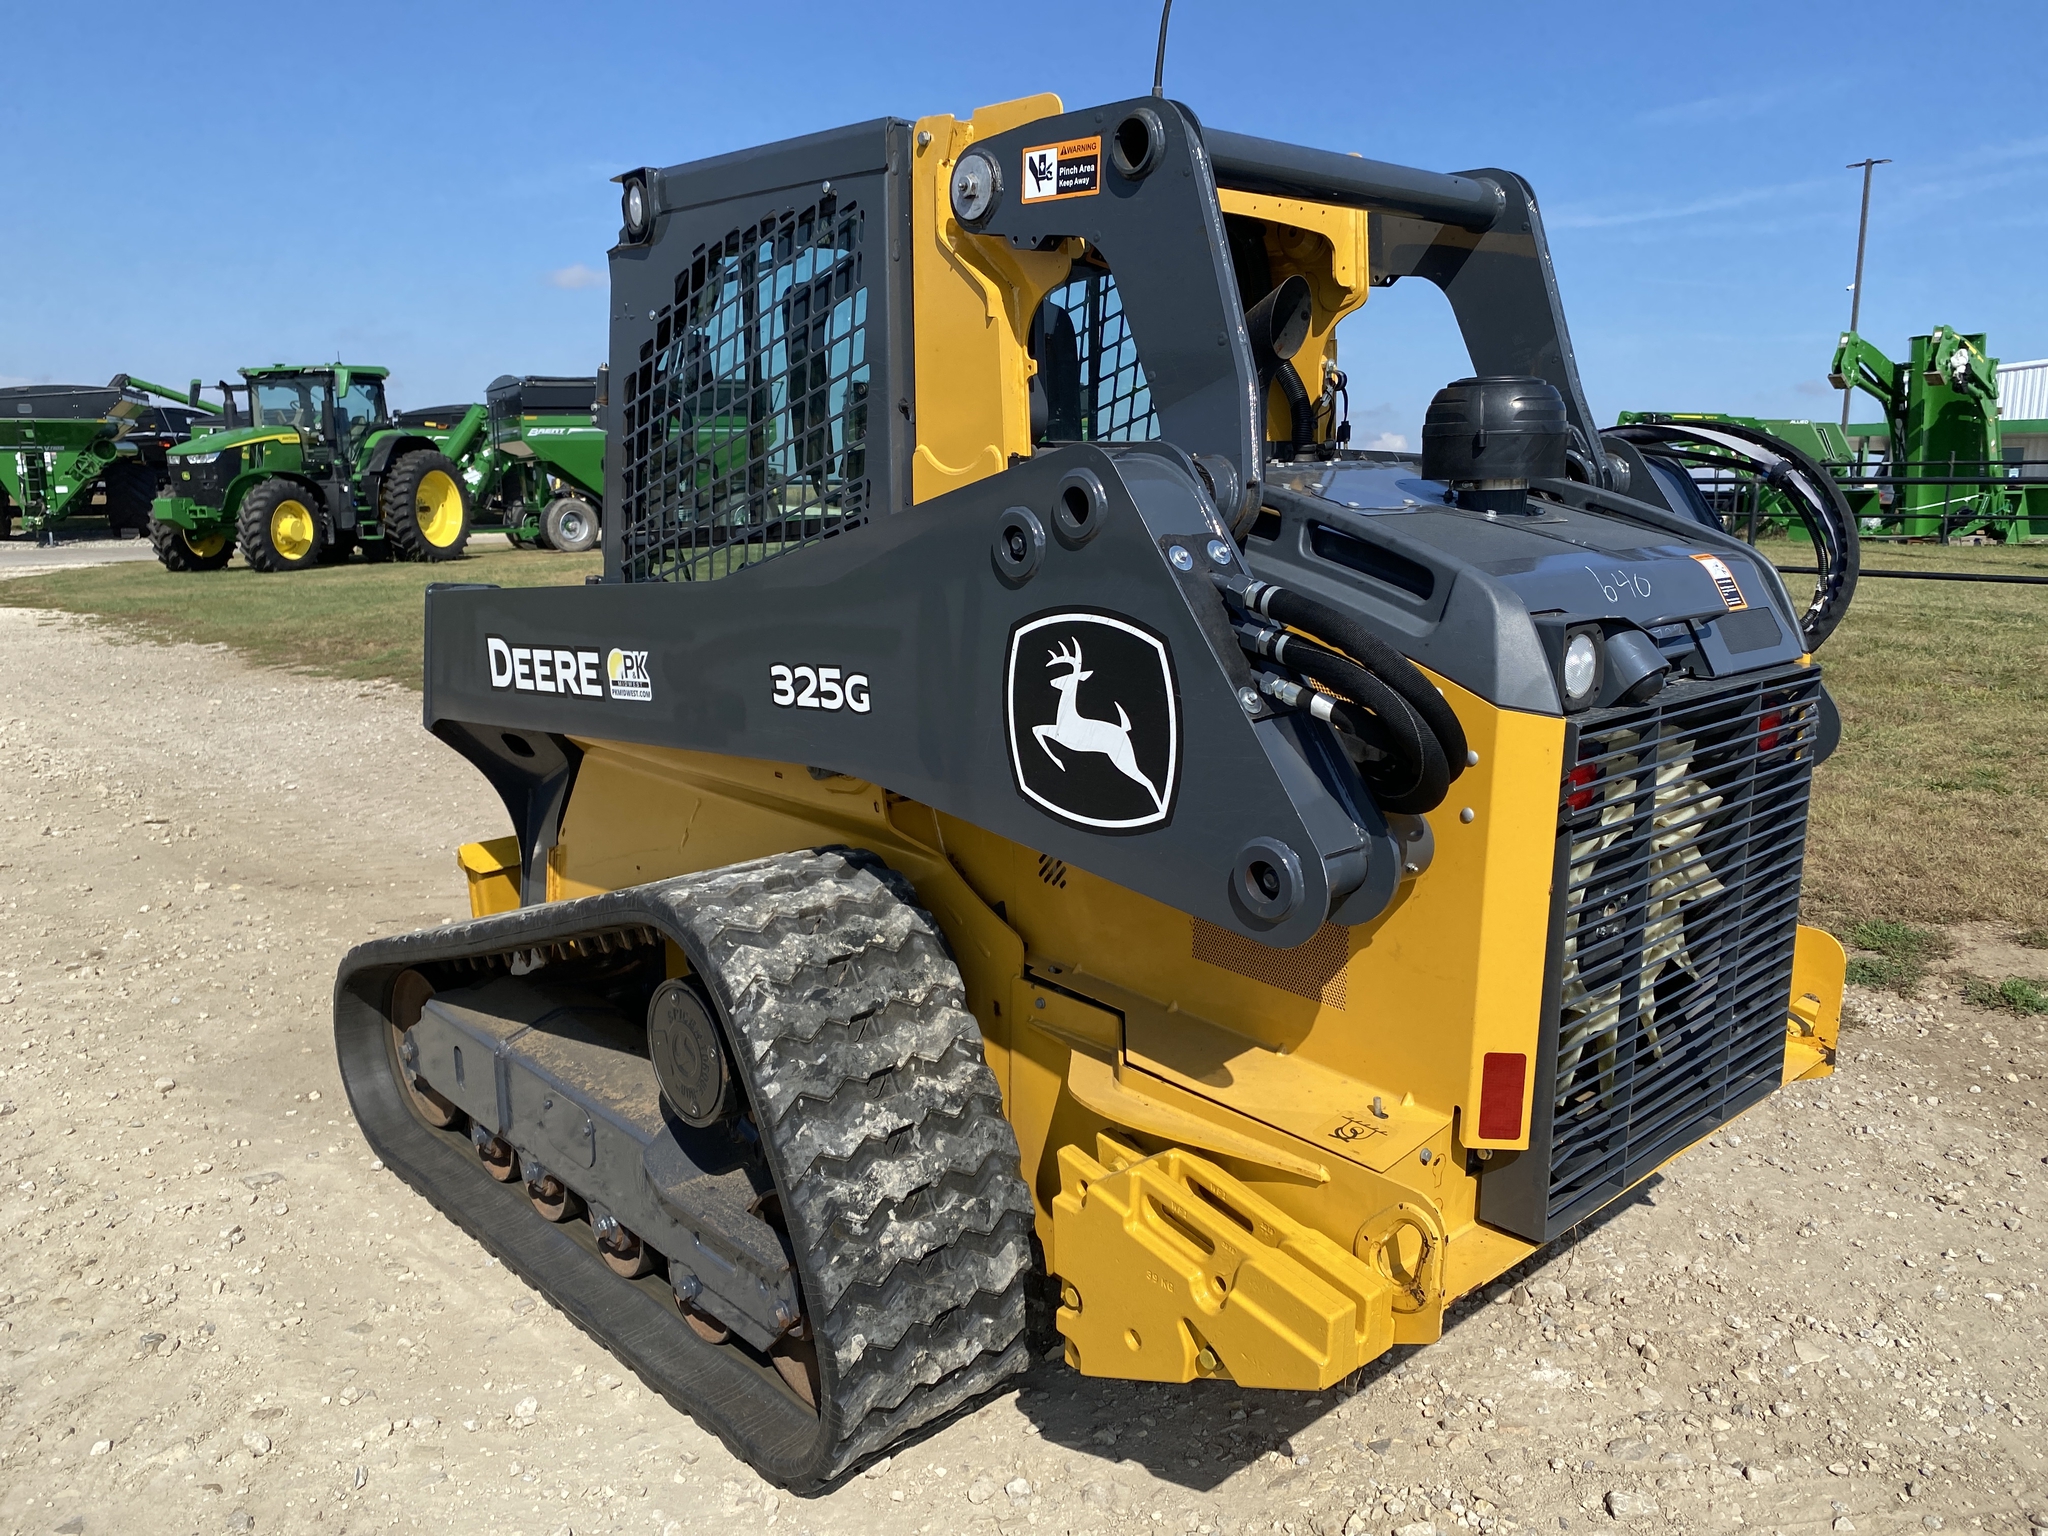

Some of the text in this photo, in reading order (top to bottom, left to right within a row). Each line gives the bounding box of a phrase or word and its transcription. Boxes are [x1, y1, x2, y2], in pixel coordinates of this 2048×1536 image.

[1066, 142, 1097, 154] WARNING
[1059, 164, 1095, 176] Pinch Area
[1059, 177, 1090, 188] Keep Away
[527, 428, 565, 437] BRENT
[486, 637, 603, 697] DEERE
[611, 689, 651, 698] PKMIDWEST.COM
[769, 663, 872, 713] 325G
